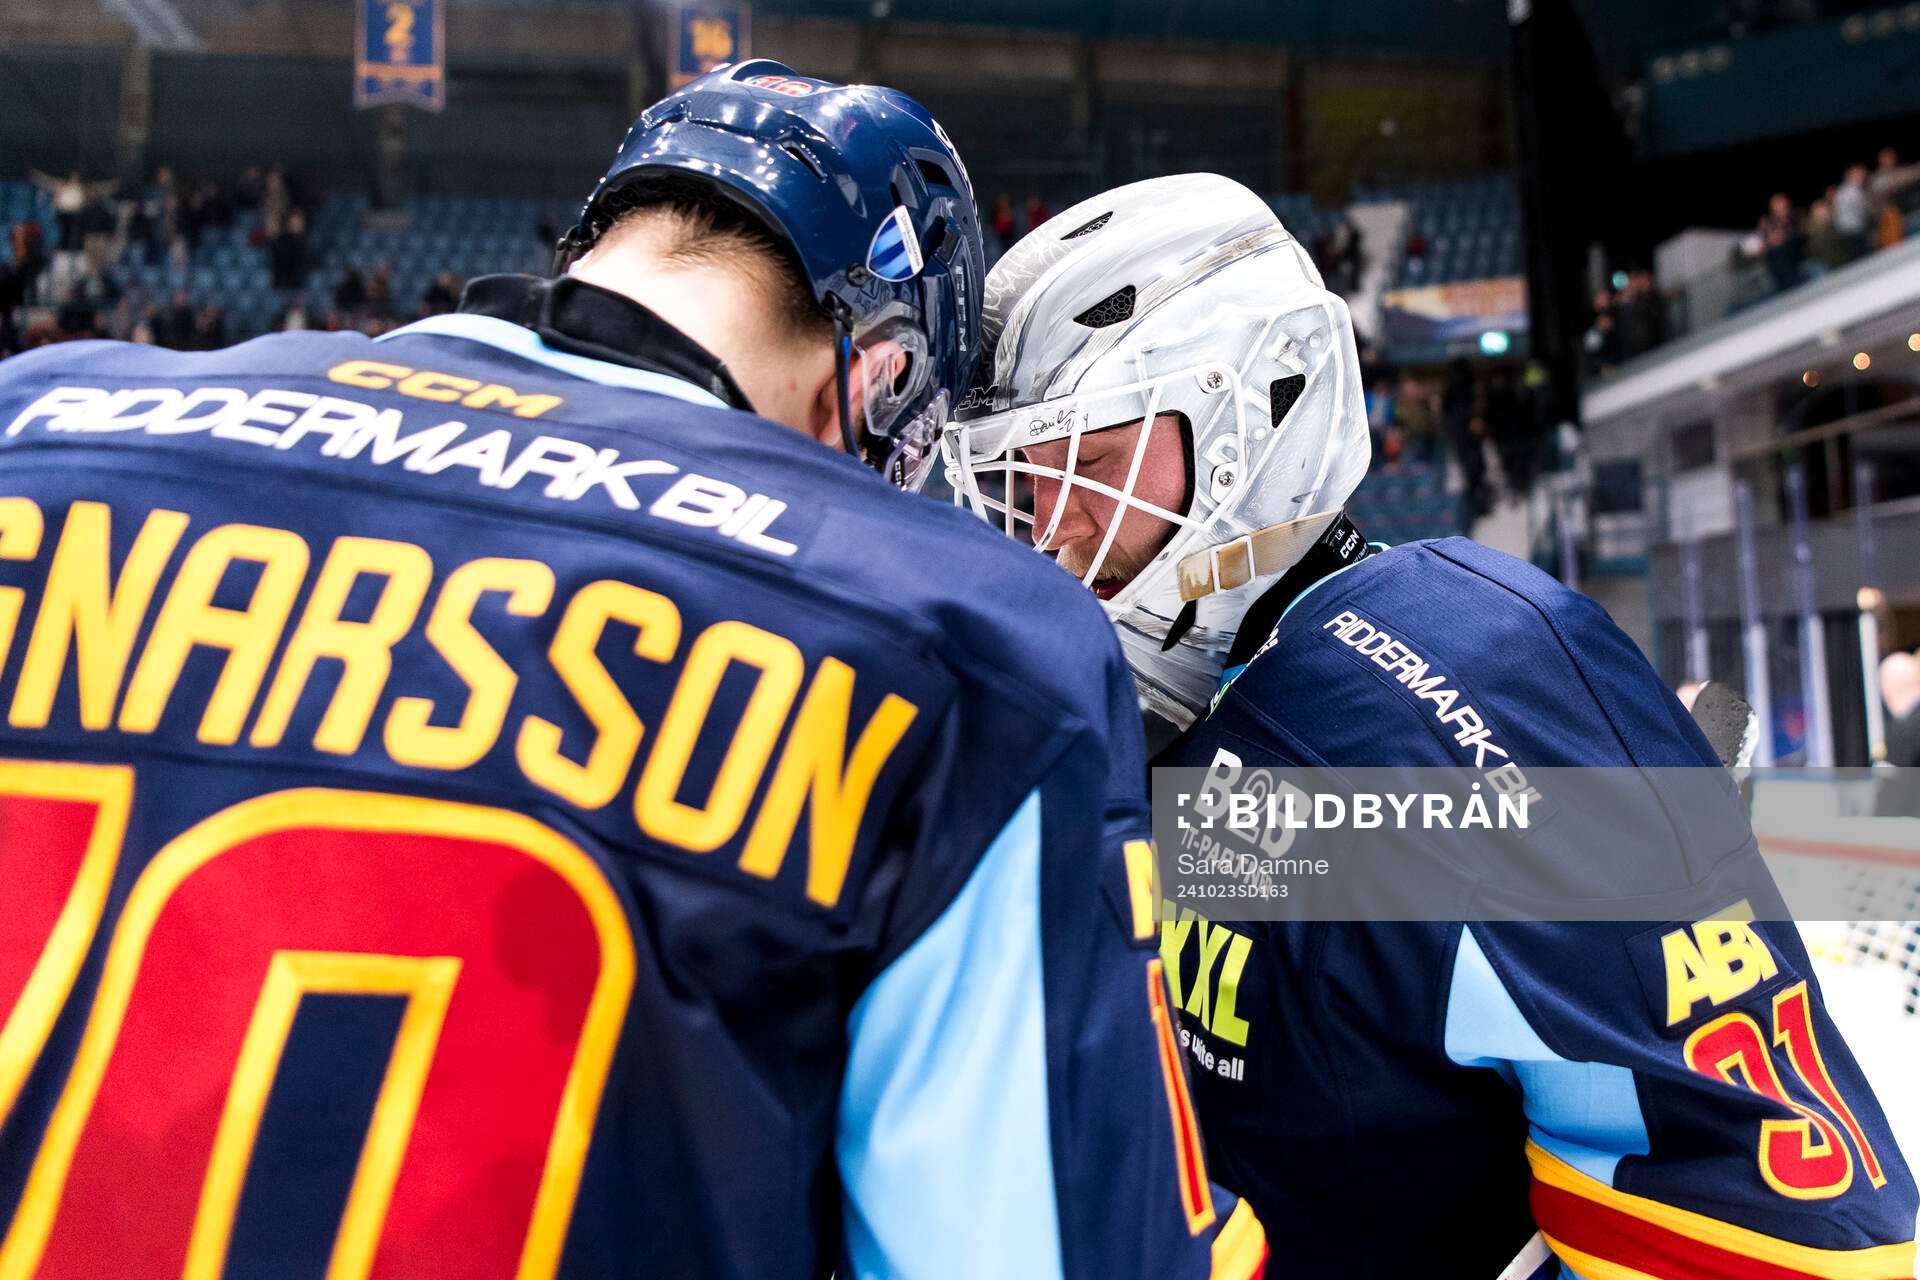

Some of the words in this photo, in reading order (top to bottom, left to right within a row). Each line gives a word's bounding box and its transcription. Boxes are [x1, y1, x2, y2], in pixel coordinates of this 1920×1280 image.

[327, 360, 564, 419] CCM
[5, 386, 681, 511] RIDDERMARK
[649, 472, 799, 557] BIL
[1323, 611, 1510, 770] RIDDERMARK
[1217, 1056, 1245, 1081] all
